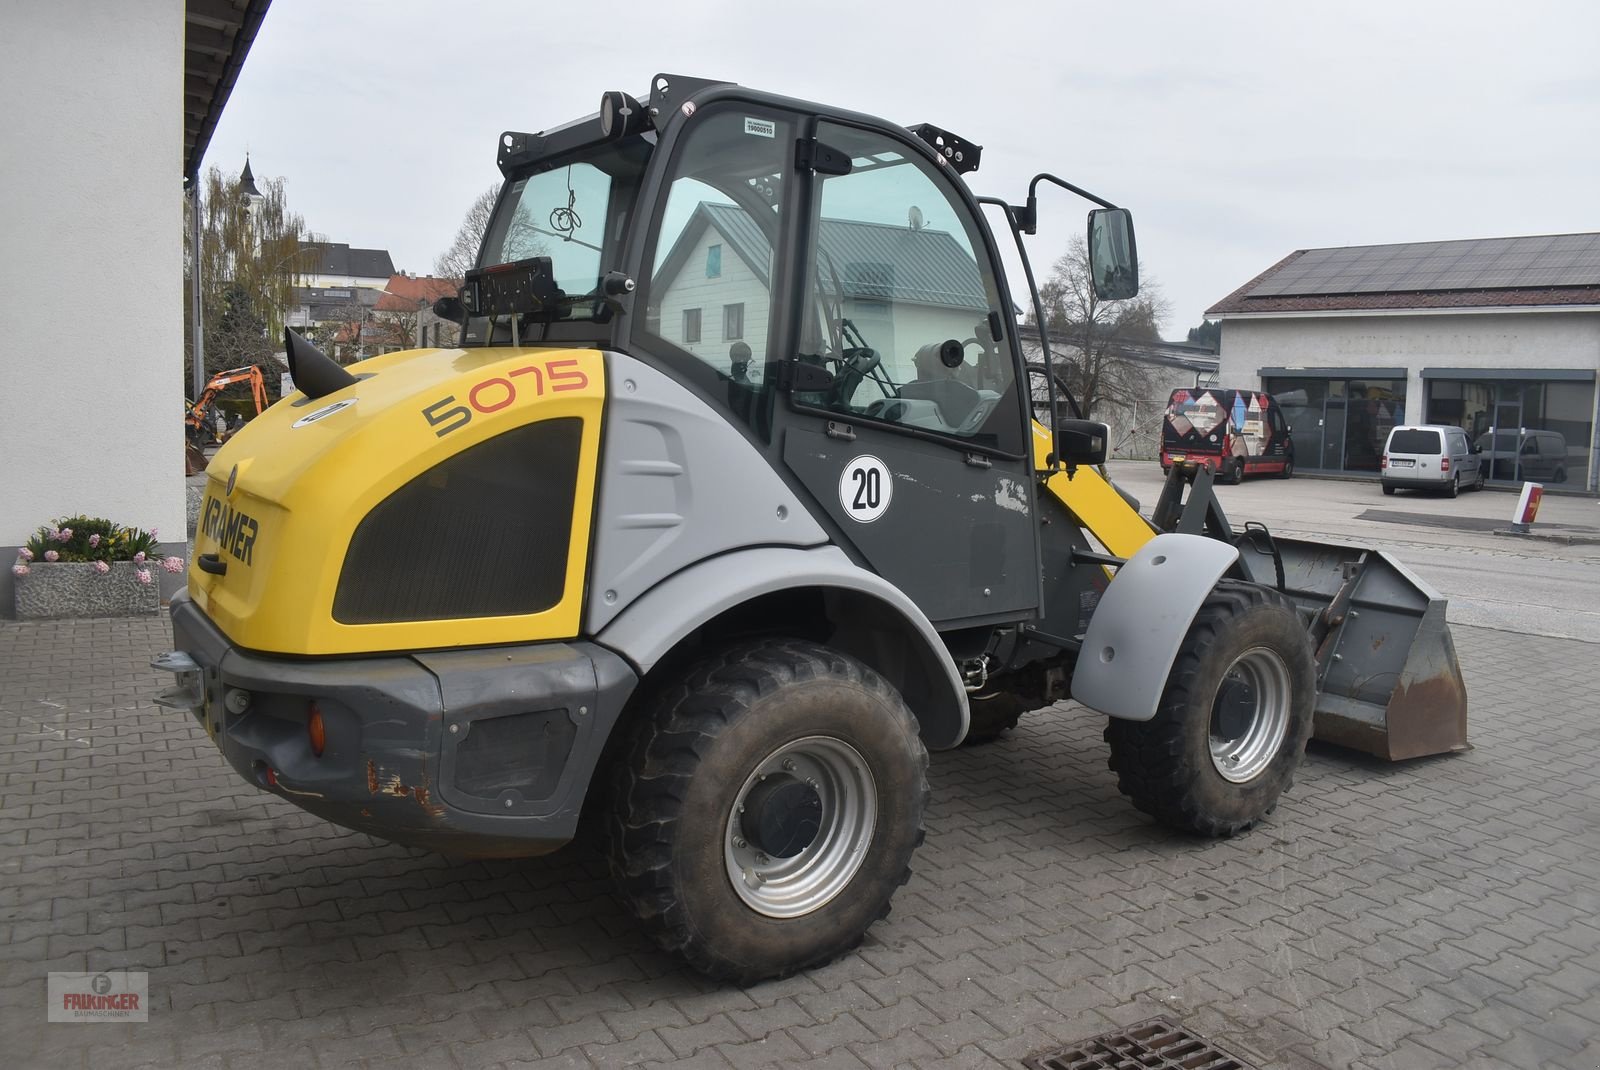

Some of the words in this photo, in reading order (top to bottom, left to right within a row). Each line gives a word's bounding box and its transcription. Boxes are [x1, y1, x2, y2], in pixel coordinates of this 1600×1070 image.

[422, 360, 588, 437] 5075
[852, 467, 881, 510] 20
[201, 495, 259, 567] KRAMER
